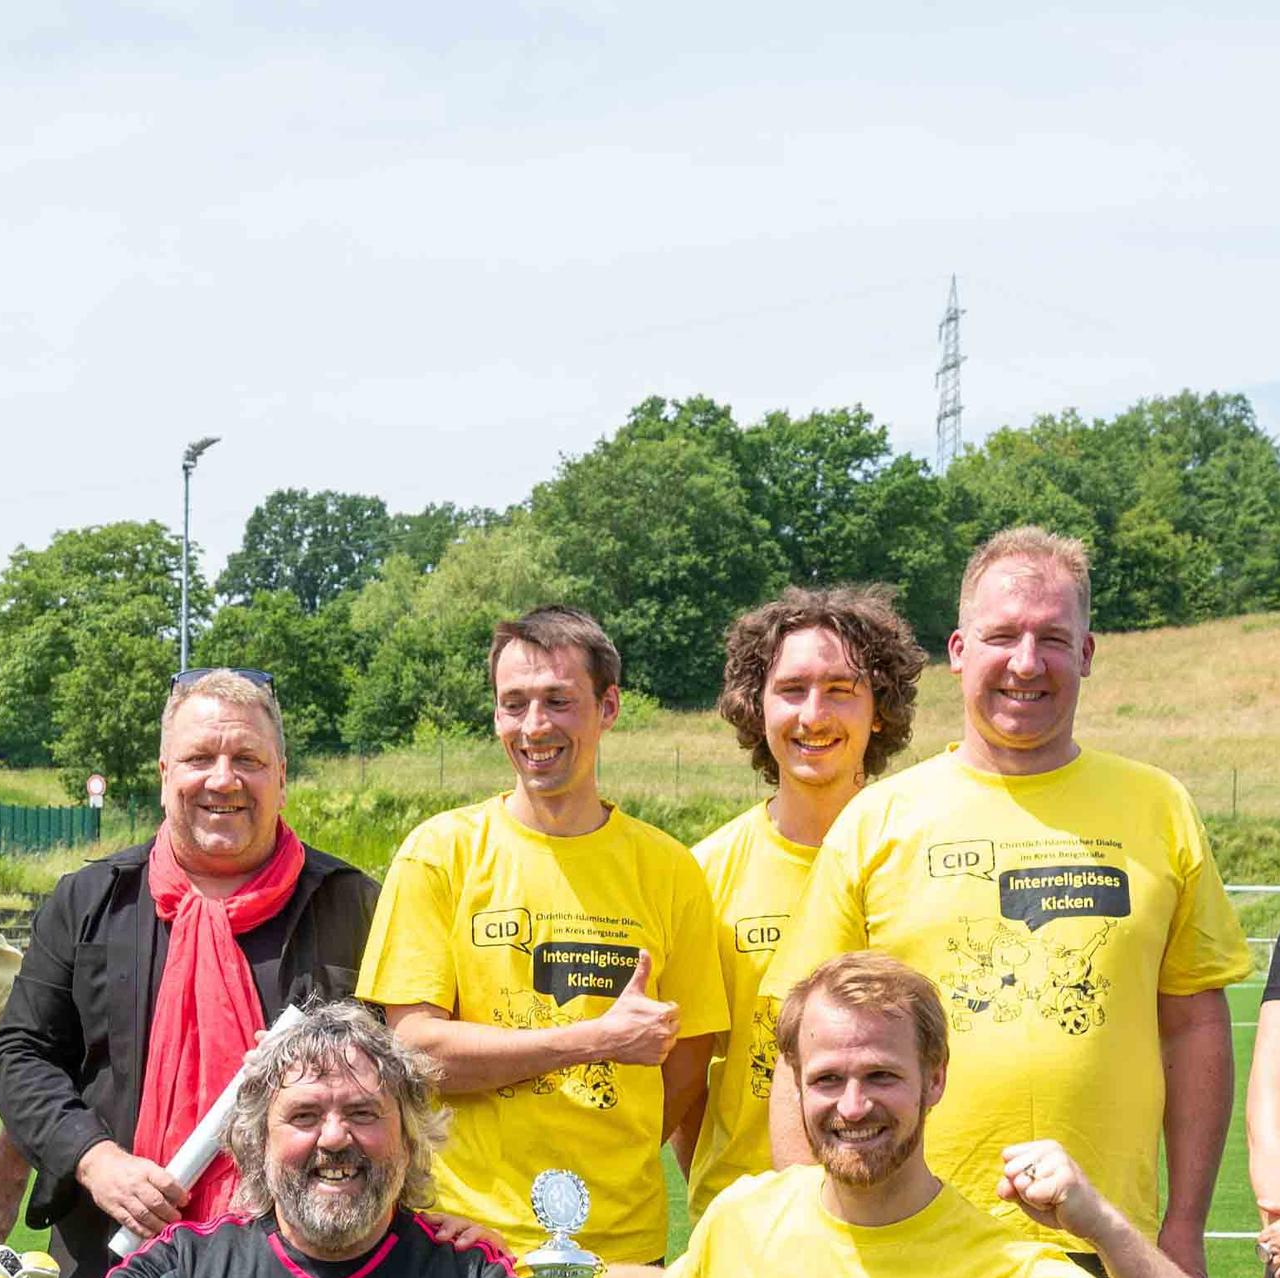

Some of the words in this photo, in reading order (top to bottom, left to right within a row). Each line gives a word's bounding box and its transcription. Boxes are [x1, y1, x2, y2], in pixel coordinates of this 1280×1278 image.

[1095, 838, 1123, 849] Dialog
[942, 851, 980, 869] CID
[1009, 872, 1121, 891] Interreligiöses
[1041, 895, 1094, 911] Kicken
[485, 921, 520, 939] CID
[747, 926, 781, 944] CID
[543, 949, 639, 968] Interreligiöses
[567, 972, 614, 989] Kicken
